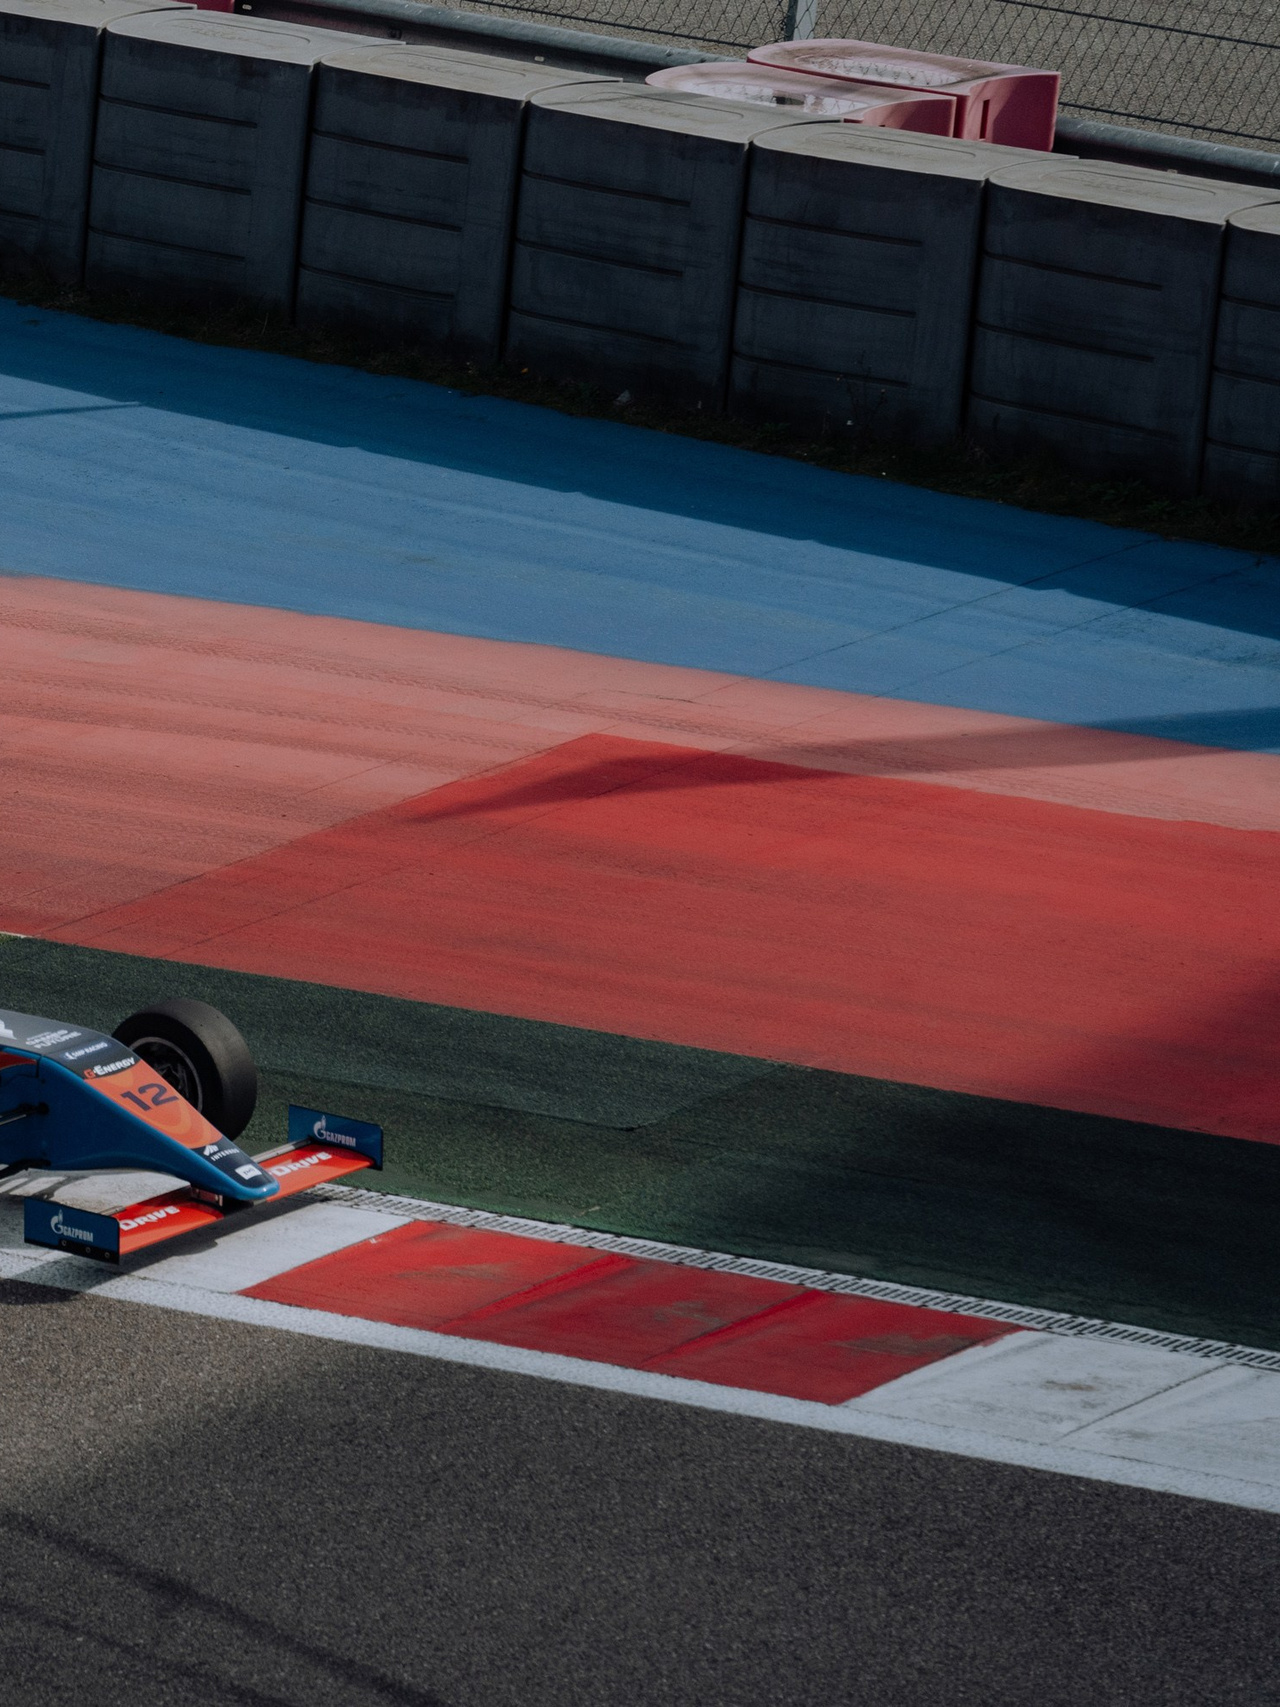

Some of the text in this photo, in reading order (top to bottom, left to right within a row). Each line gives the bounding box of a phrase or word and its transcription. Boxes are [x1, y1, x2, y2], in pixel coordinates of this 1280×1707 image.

[83, 1057, 135, 1079] G-ENERGY
[120, 1083, 179, 1112] 12
[326, 1130, 356, 1148] GAZPROM
[63, 1226, 93, 1243] GAZPROM
